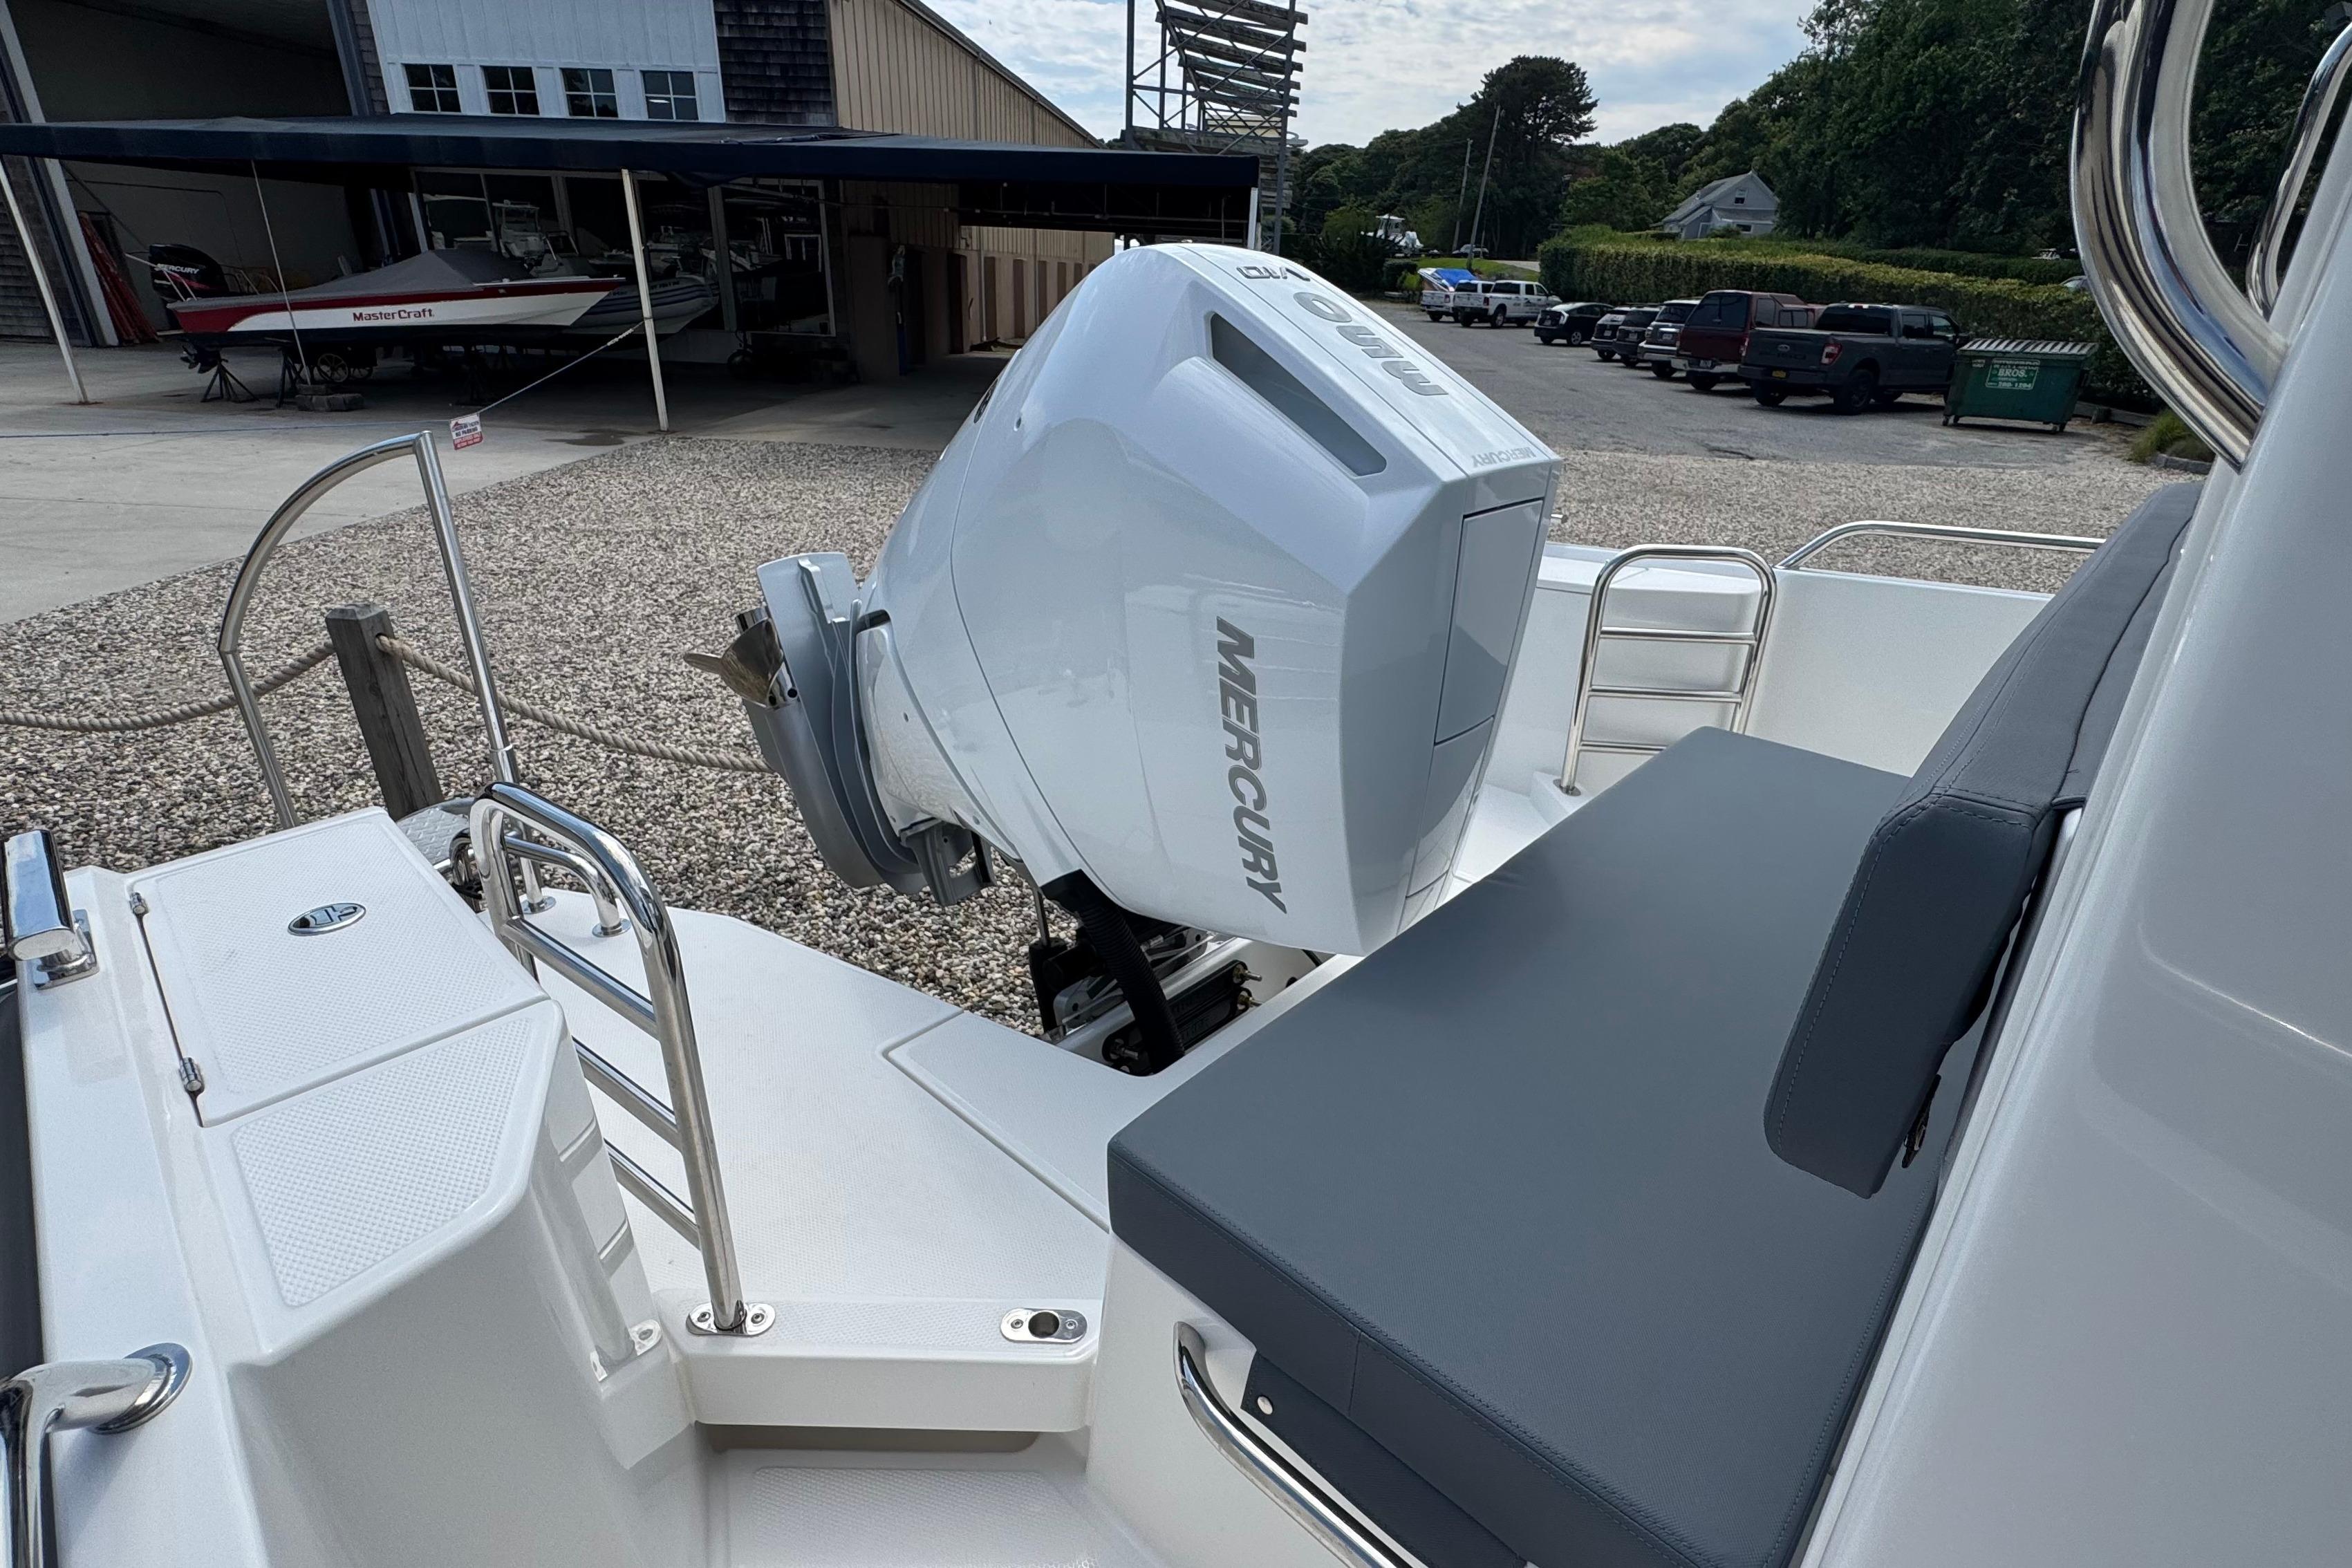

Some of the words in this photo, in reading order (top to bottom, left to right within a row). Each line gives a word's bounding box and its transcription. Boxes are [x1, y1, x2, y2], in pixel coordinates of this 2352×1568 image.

[1236, 265, 1311, 282] V10
[353, 308, 433, 321] MasterCraft
[1293, 292, 1449, 396] 350
[1998, 368, 2027, 377] BROS.
[1471, 447, 1536, 468] MERCURY
[1215, 615, 1287, 915] MERCURY
